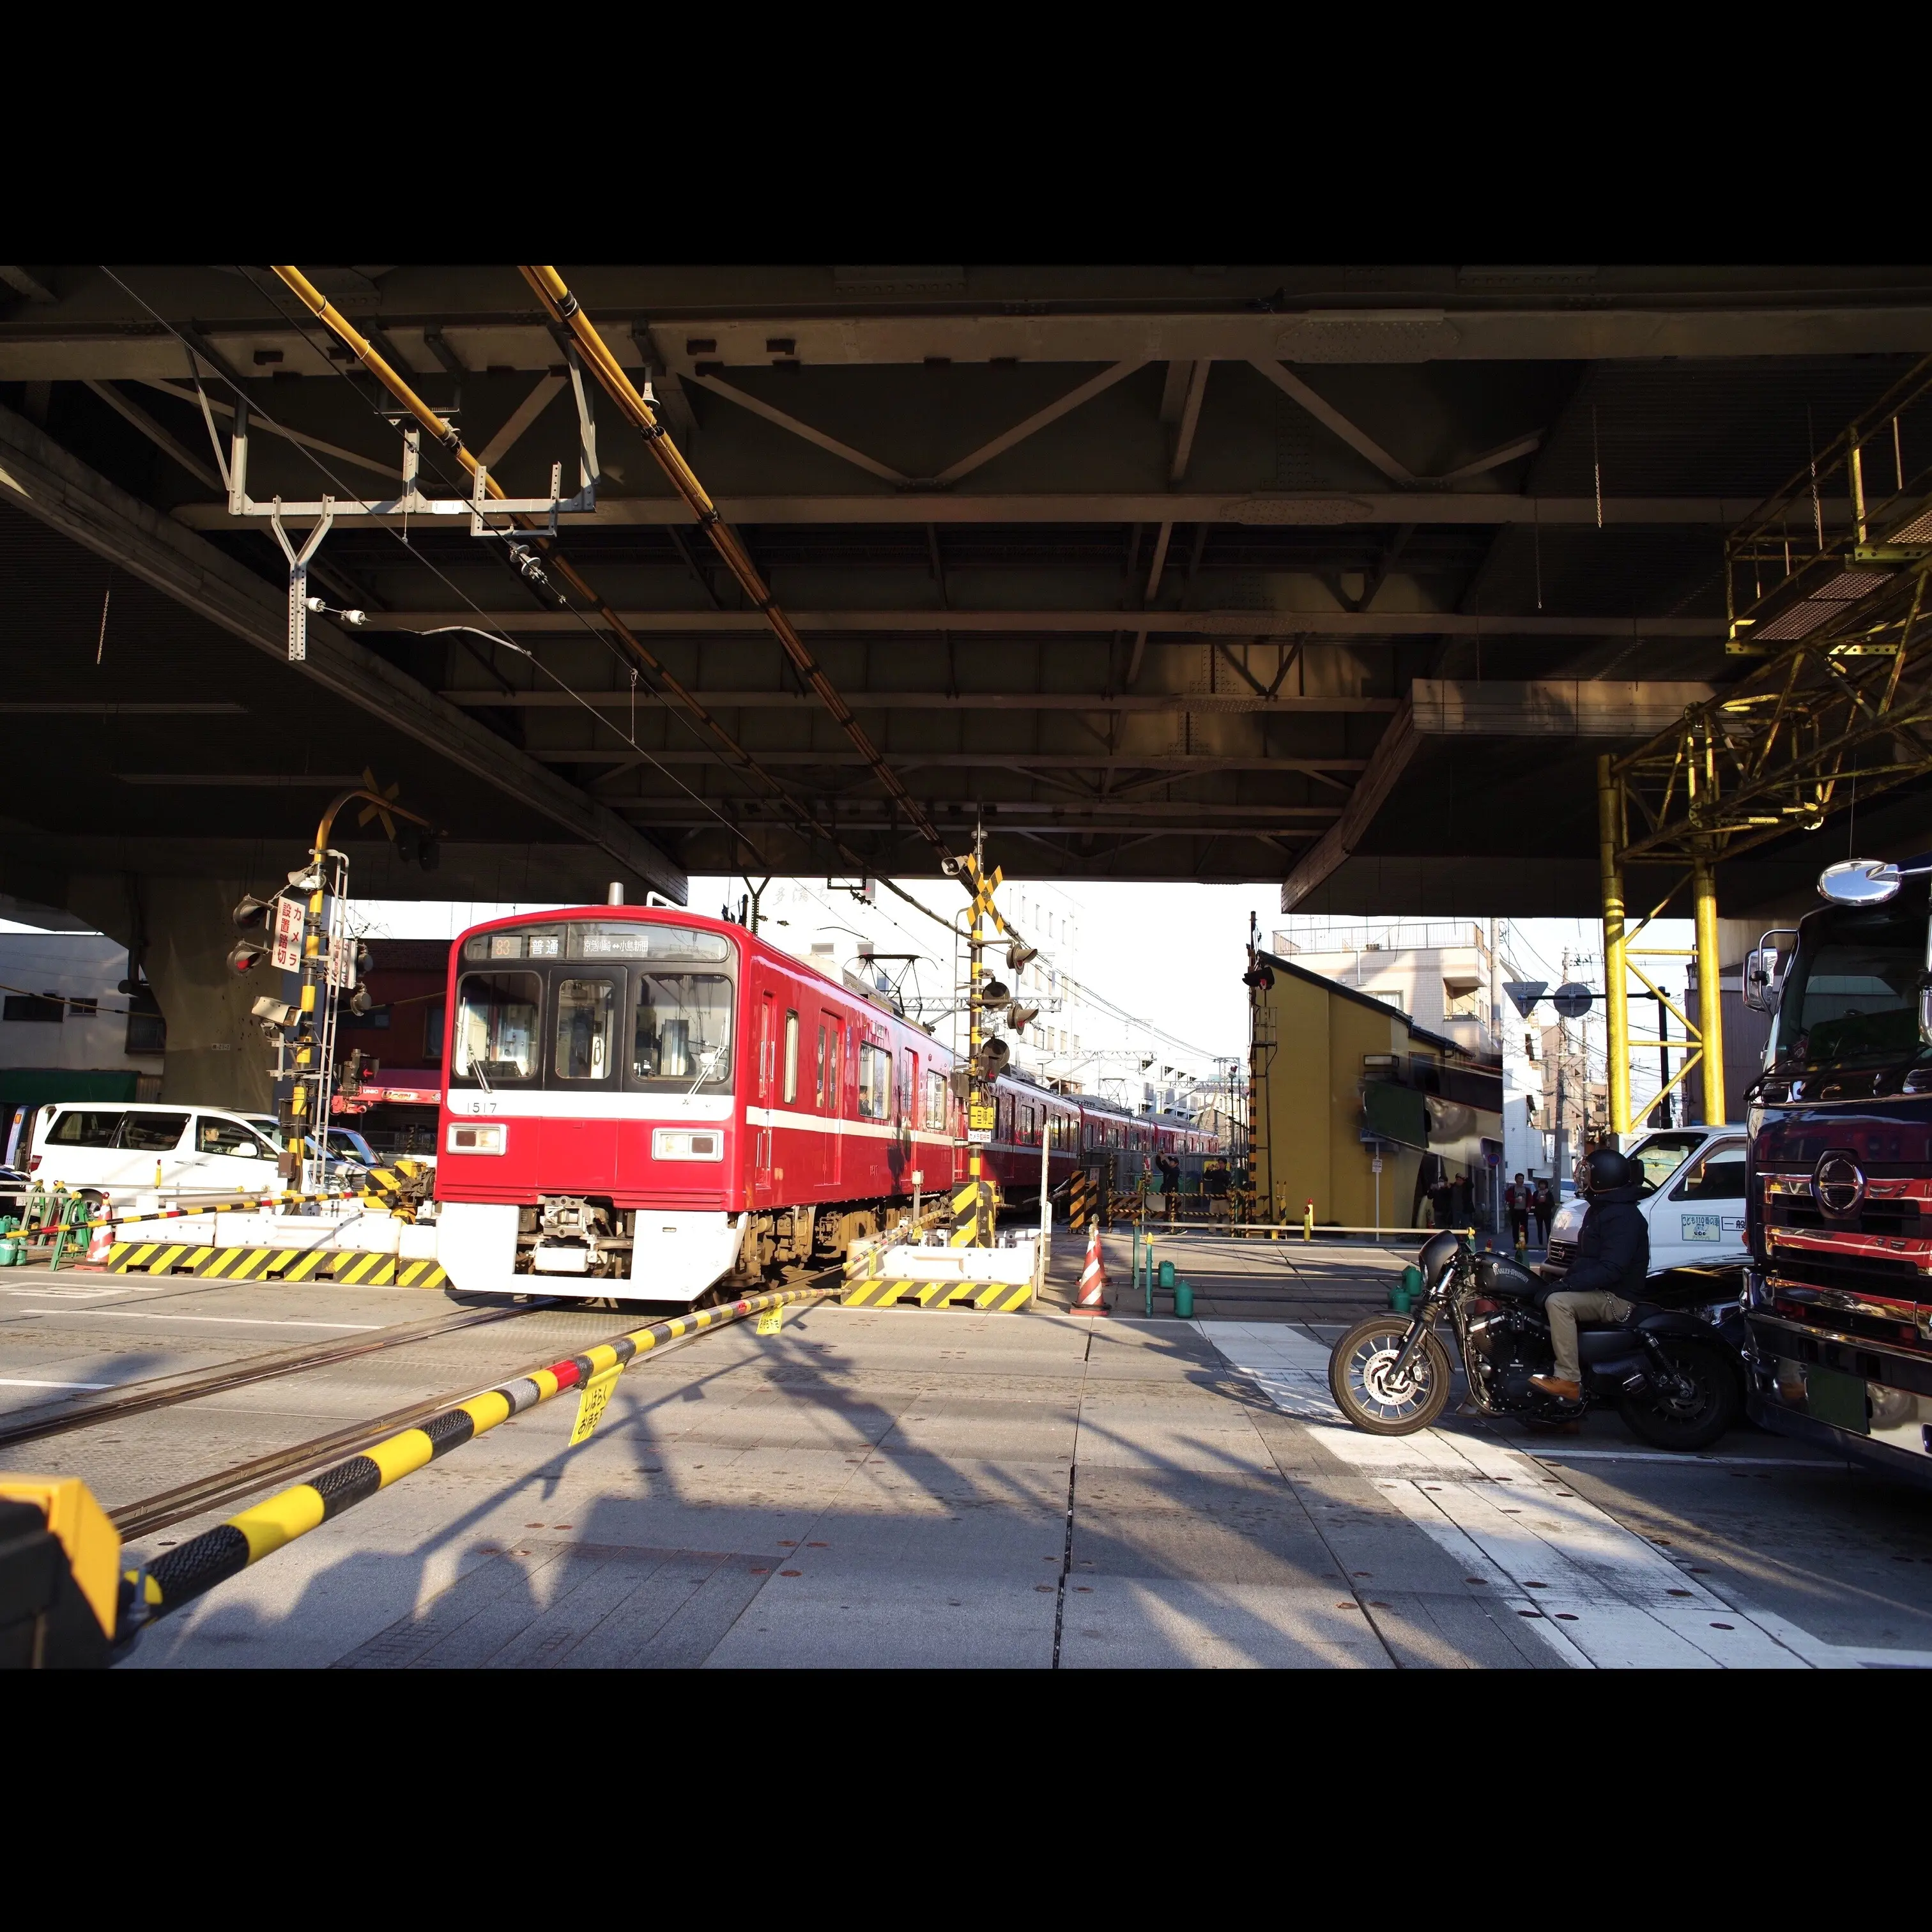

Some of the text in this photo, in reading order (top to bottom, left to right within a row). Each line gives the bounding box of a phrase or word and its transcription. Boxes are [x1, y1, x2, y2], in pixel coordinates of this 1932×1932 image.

[277, 902, 292, 965] 設置踏切
[289, 907, 302, 966] カメラ
[496, 939, 510, 955] 83
[531, 939, 558, 954] 普通
[584, 940, 648, 953] 京急川崎 小島新田
[467, 1102, 497, 1113] 1517
[970, 1110, 993, 1124] 一旦停止
[1682, 1216, 1719, 1227] こども110番の車
